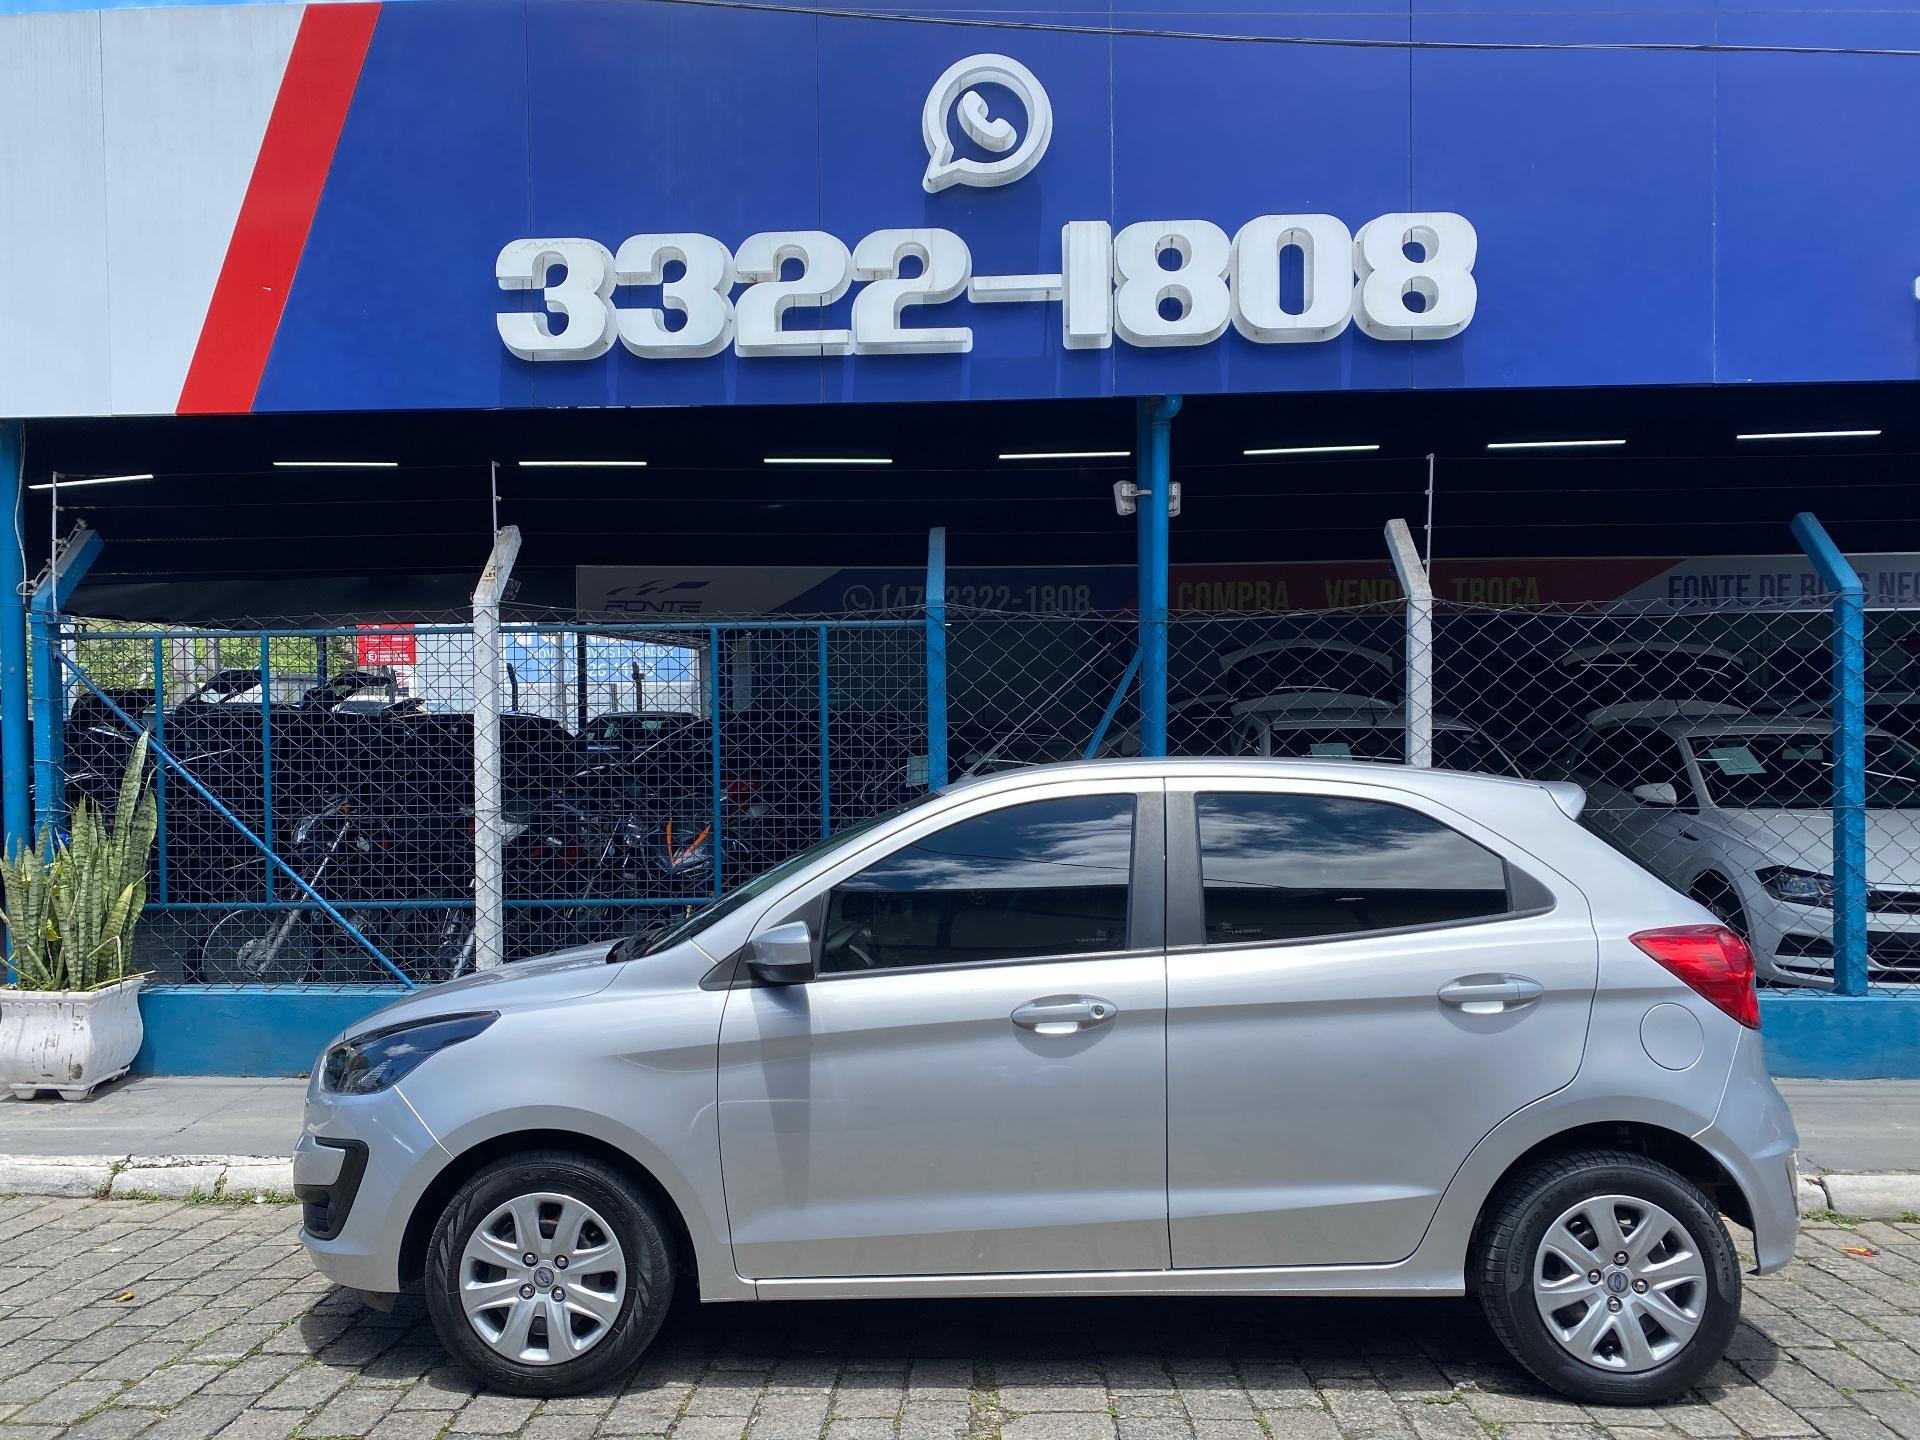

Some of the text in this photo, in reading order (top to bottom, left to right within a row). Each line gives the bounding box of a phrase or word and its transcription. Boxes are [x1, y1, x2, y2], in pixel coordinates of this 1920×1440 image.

[496, 212, 1478, 361] 3322-1808
[1179, 581, 1290, 612] COMPRA
[1452, 576, 1540, 609] TROCA
[1669, 574, 1751, 606] FONTE
[1759, 573, 1793, 605] DE
